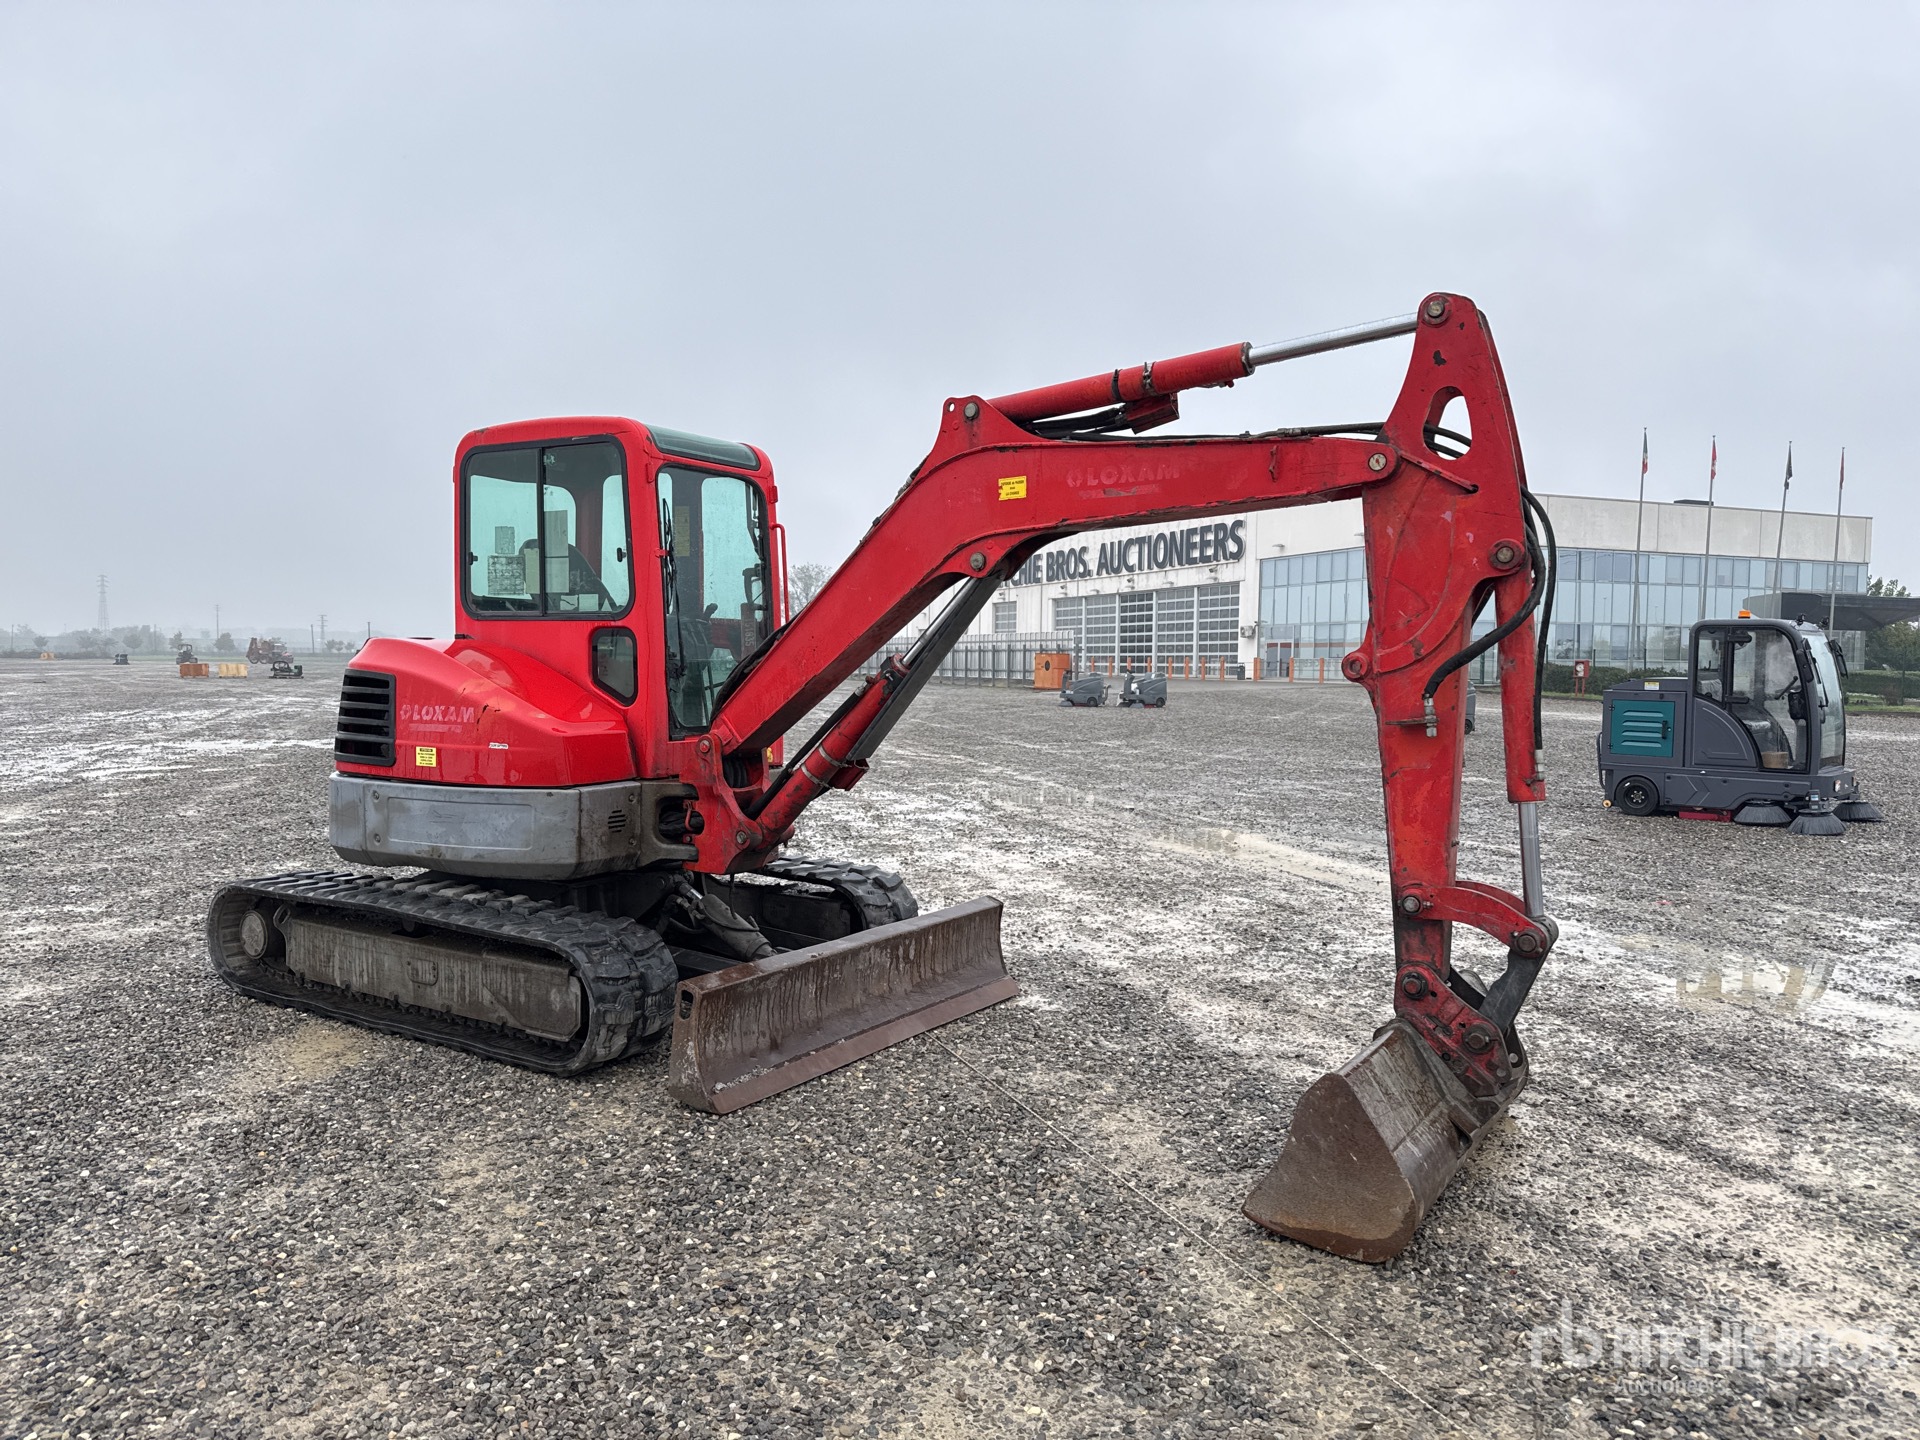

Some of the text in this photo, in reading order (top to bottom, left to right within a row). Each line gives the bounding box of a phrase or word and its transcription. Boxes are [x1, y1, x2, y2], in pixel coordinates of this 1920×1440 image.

[1086, 463, 1180, 487] LOXAM
[1046, 546, 1093, 582] BROS.
[1096, 519, 1246, 576] AUCTIONEERS
[412, 704, 476, 723] LOXAM
